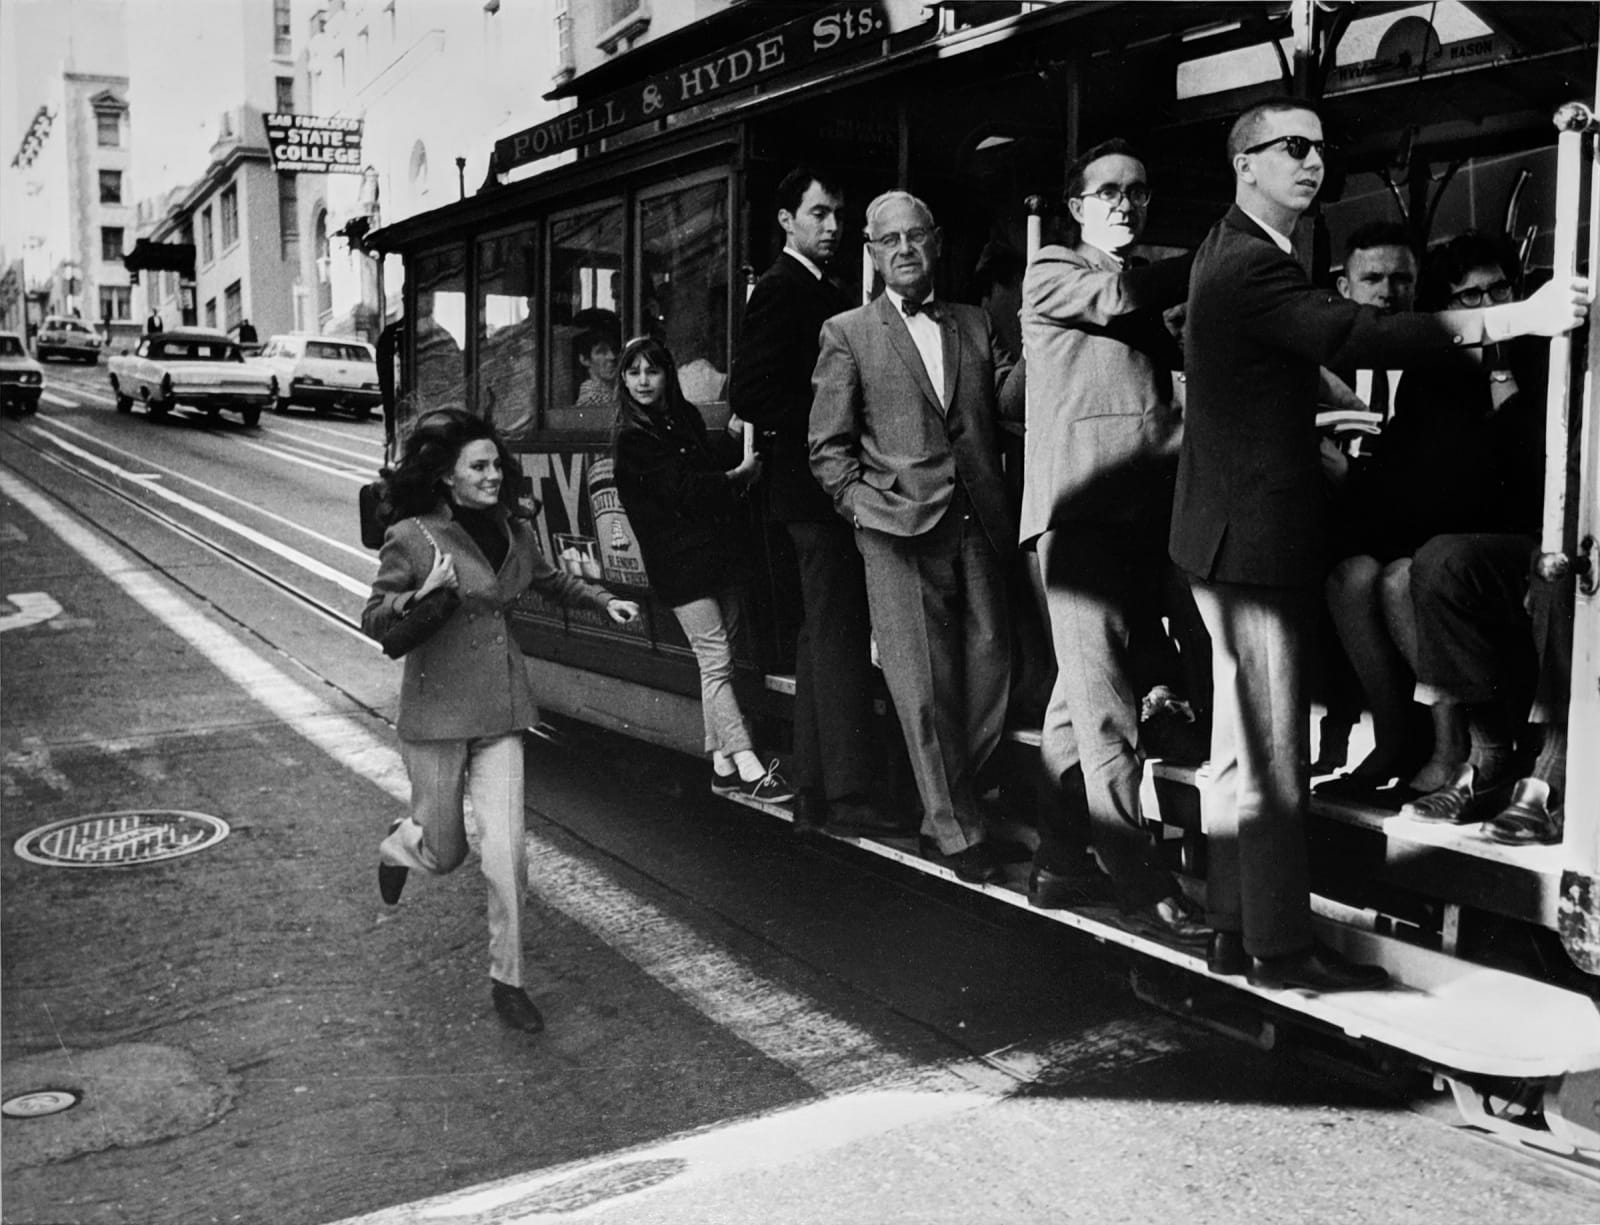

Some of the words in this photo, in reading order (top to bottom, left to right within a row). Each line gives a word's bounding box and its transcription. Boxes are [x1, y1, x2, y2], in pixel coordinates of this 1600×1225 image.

[1450, 40, 1493, 59] MASON
[514, 103, 625, 161] POWELL
[641, 84, 664, 115] &
[679, 35, 786, 101] HYDE
[812, 7, 883, 53] Sts.
[287, 128, 343, 147] STATE
[275, 145, 360, 163] COLLEGE
